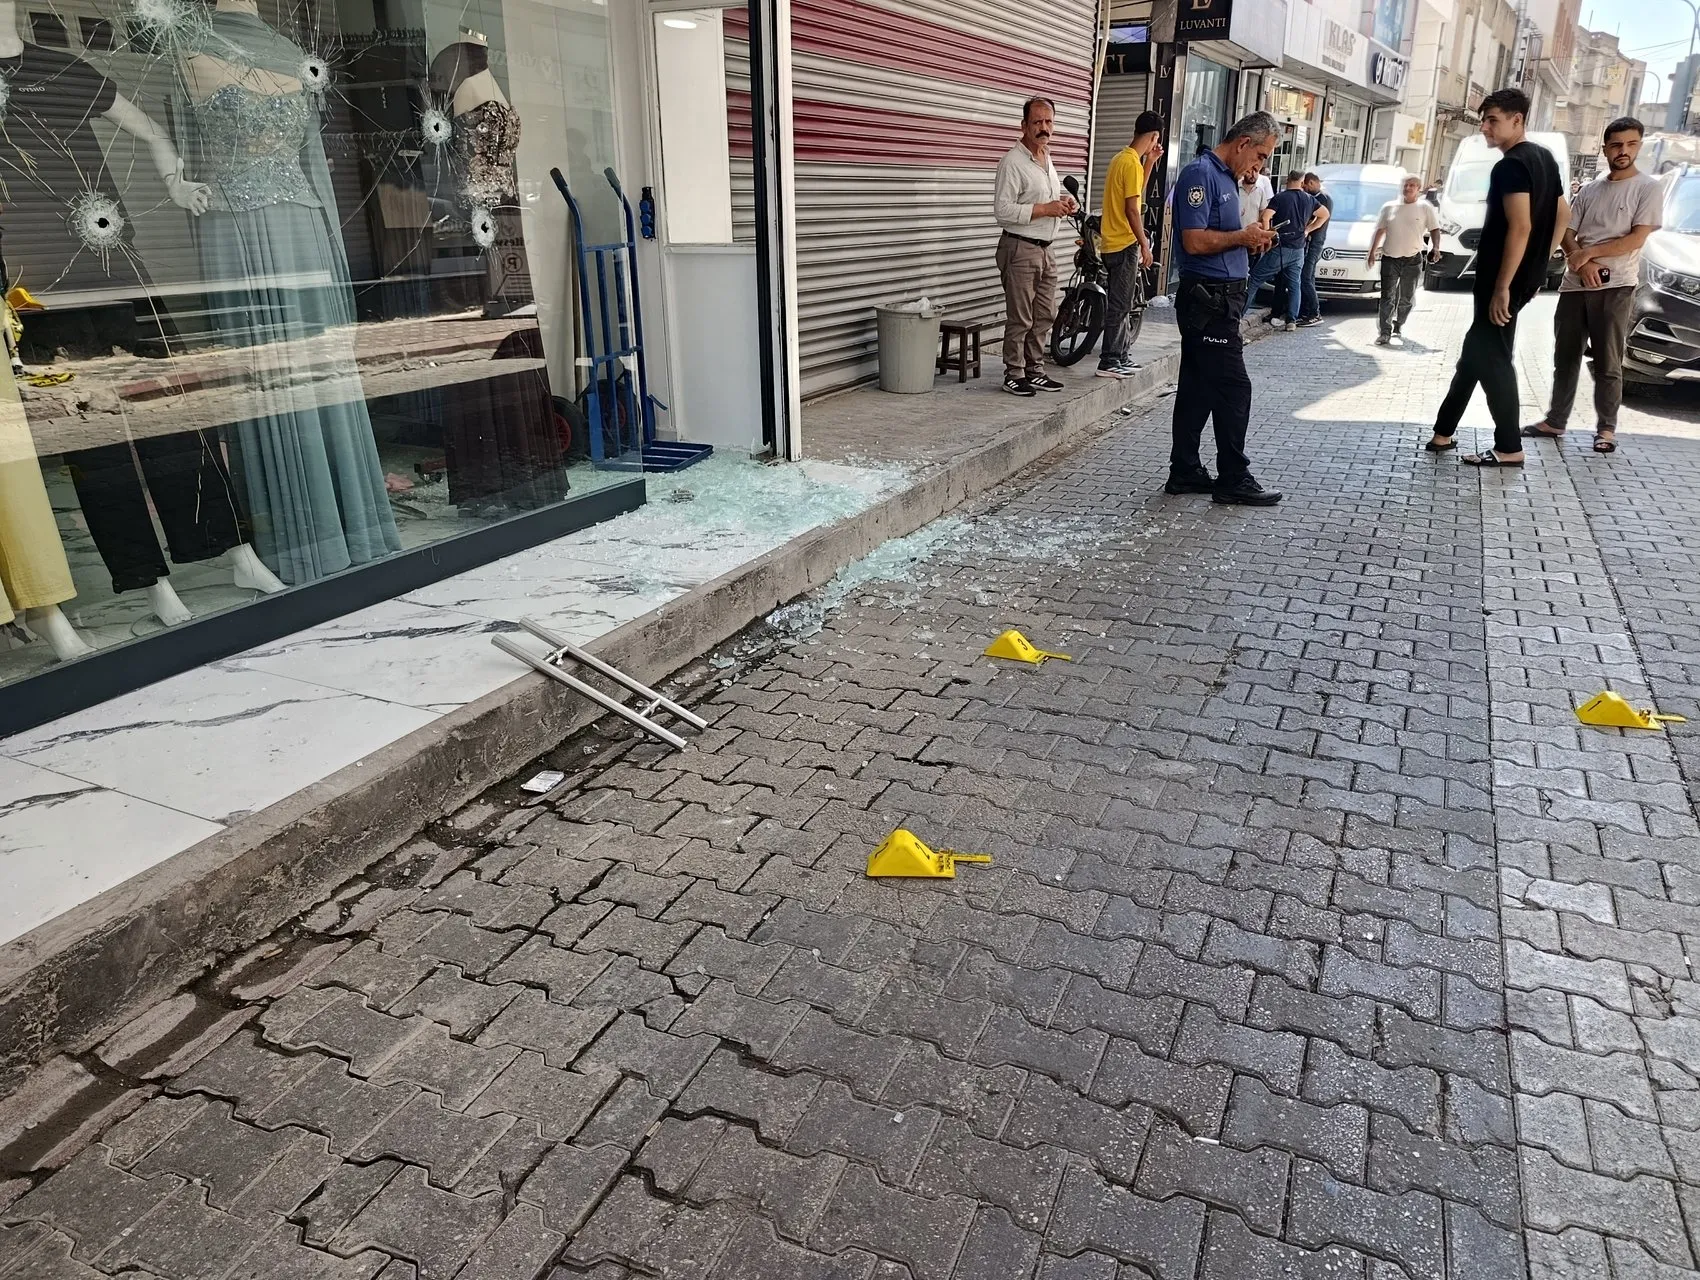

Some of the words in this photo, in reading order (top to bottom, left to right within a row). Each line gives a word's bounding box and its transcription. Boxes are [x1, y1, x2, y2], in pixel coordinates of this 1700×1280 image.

[1180, 18, 1226, 30] LUVANTI
[1319, 268, 1328, 276] SR
[1017, 638, 1029, 651] 3
